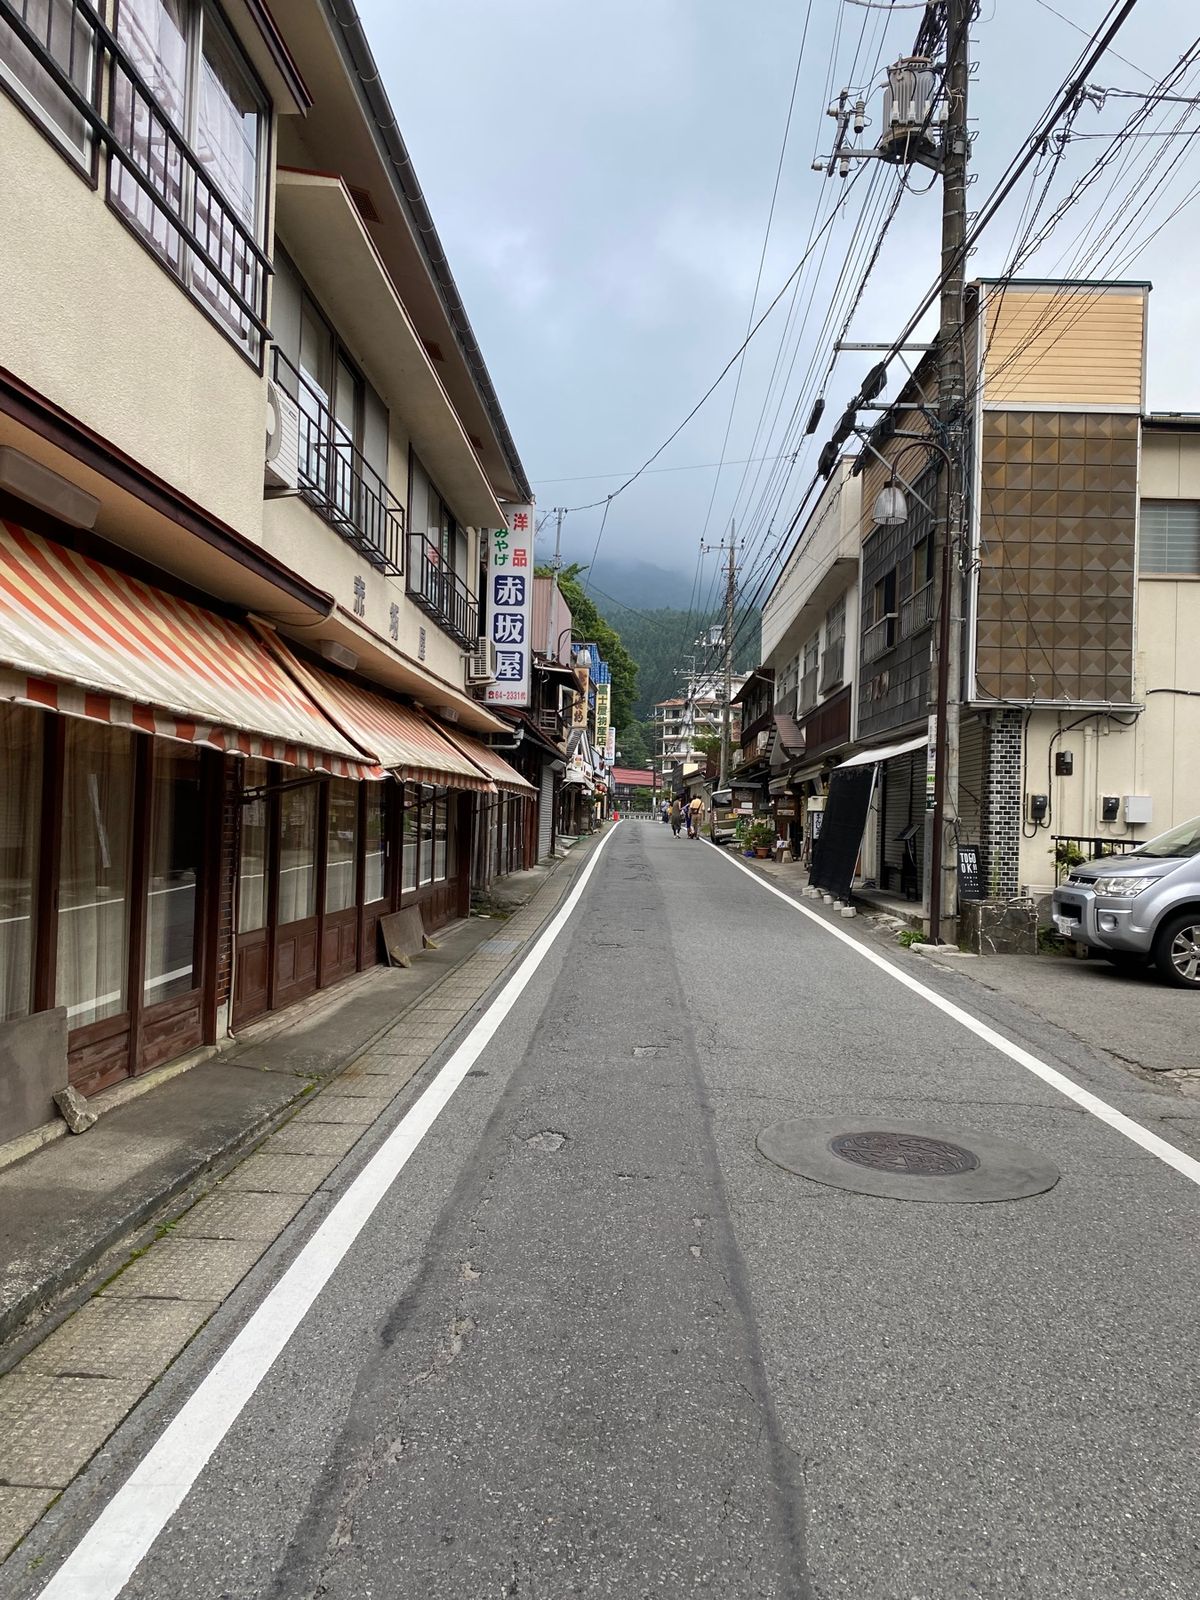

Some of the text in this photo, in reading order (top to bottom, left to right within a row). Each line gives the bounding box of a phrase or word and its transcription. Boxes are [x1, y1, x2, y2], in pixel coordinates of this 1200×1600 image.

[494, 514, 509, 566] みやげ
[513, 513, 528, 567] 洋品
[495, 576, 524, 681] 赤坂屋
